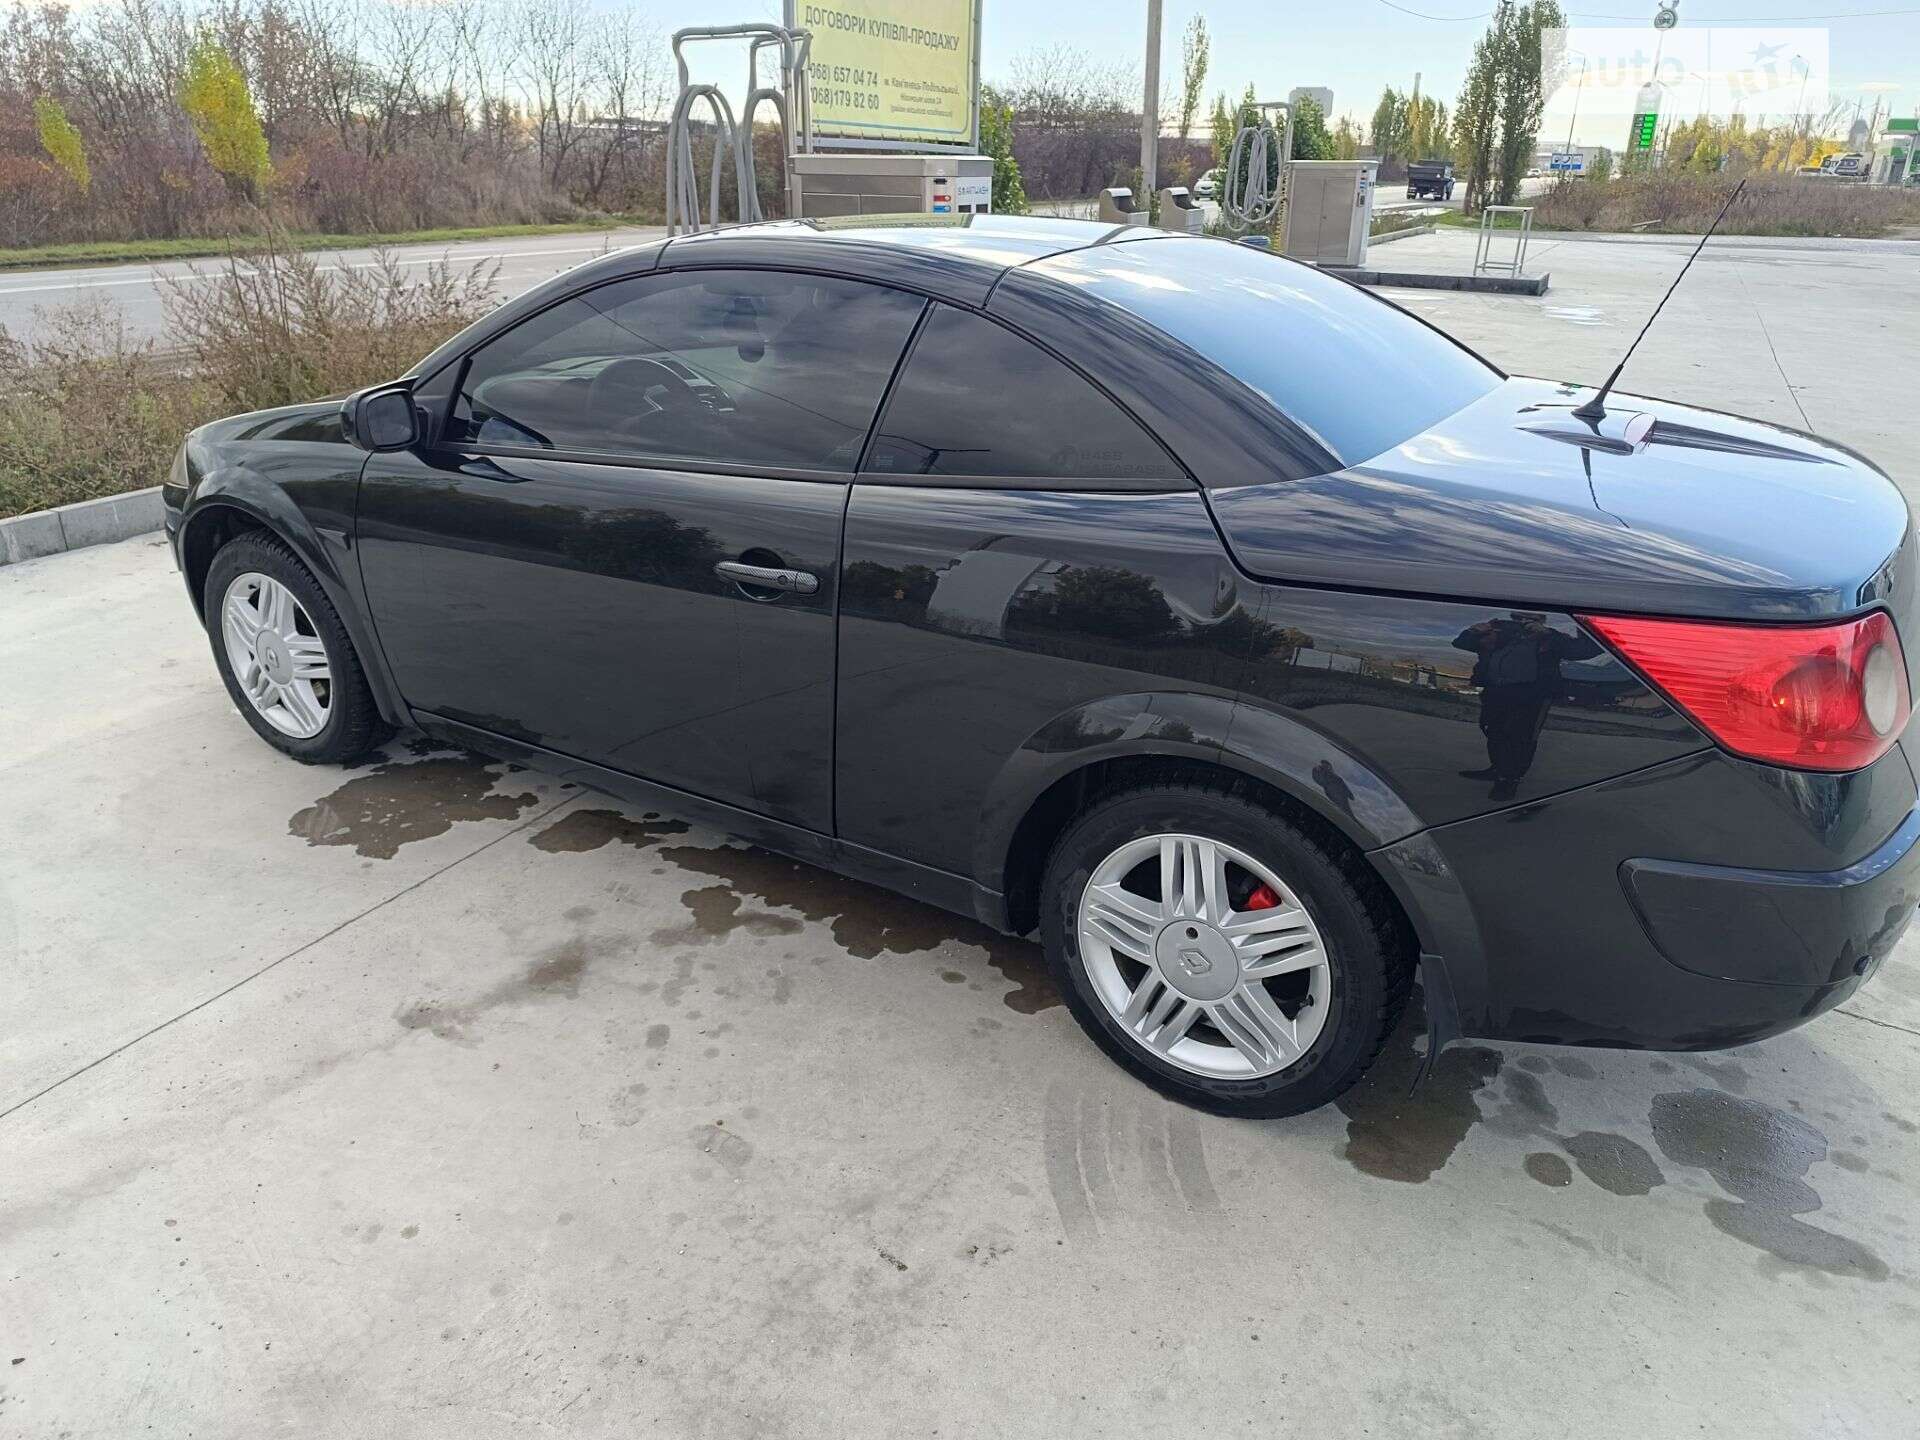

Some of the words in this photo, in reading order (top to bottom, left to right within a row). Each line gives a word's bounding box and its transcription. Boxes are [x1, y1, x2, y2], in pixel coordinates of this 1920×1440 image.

[804, 5, 866, 35] ДОГОВОРИ
[868, 19, 960, 51] КУПІВЛІ-ПРОДАЖУ
[811, 63, 830, 84] 068)
[834, 66, 850, 83] 657
[853, 69, 865, 85] 04
[867, 71, 878, 87] 74
[854, 91, 865, 109] 82
[867, 94, 879, 110] 60
